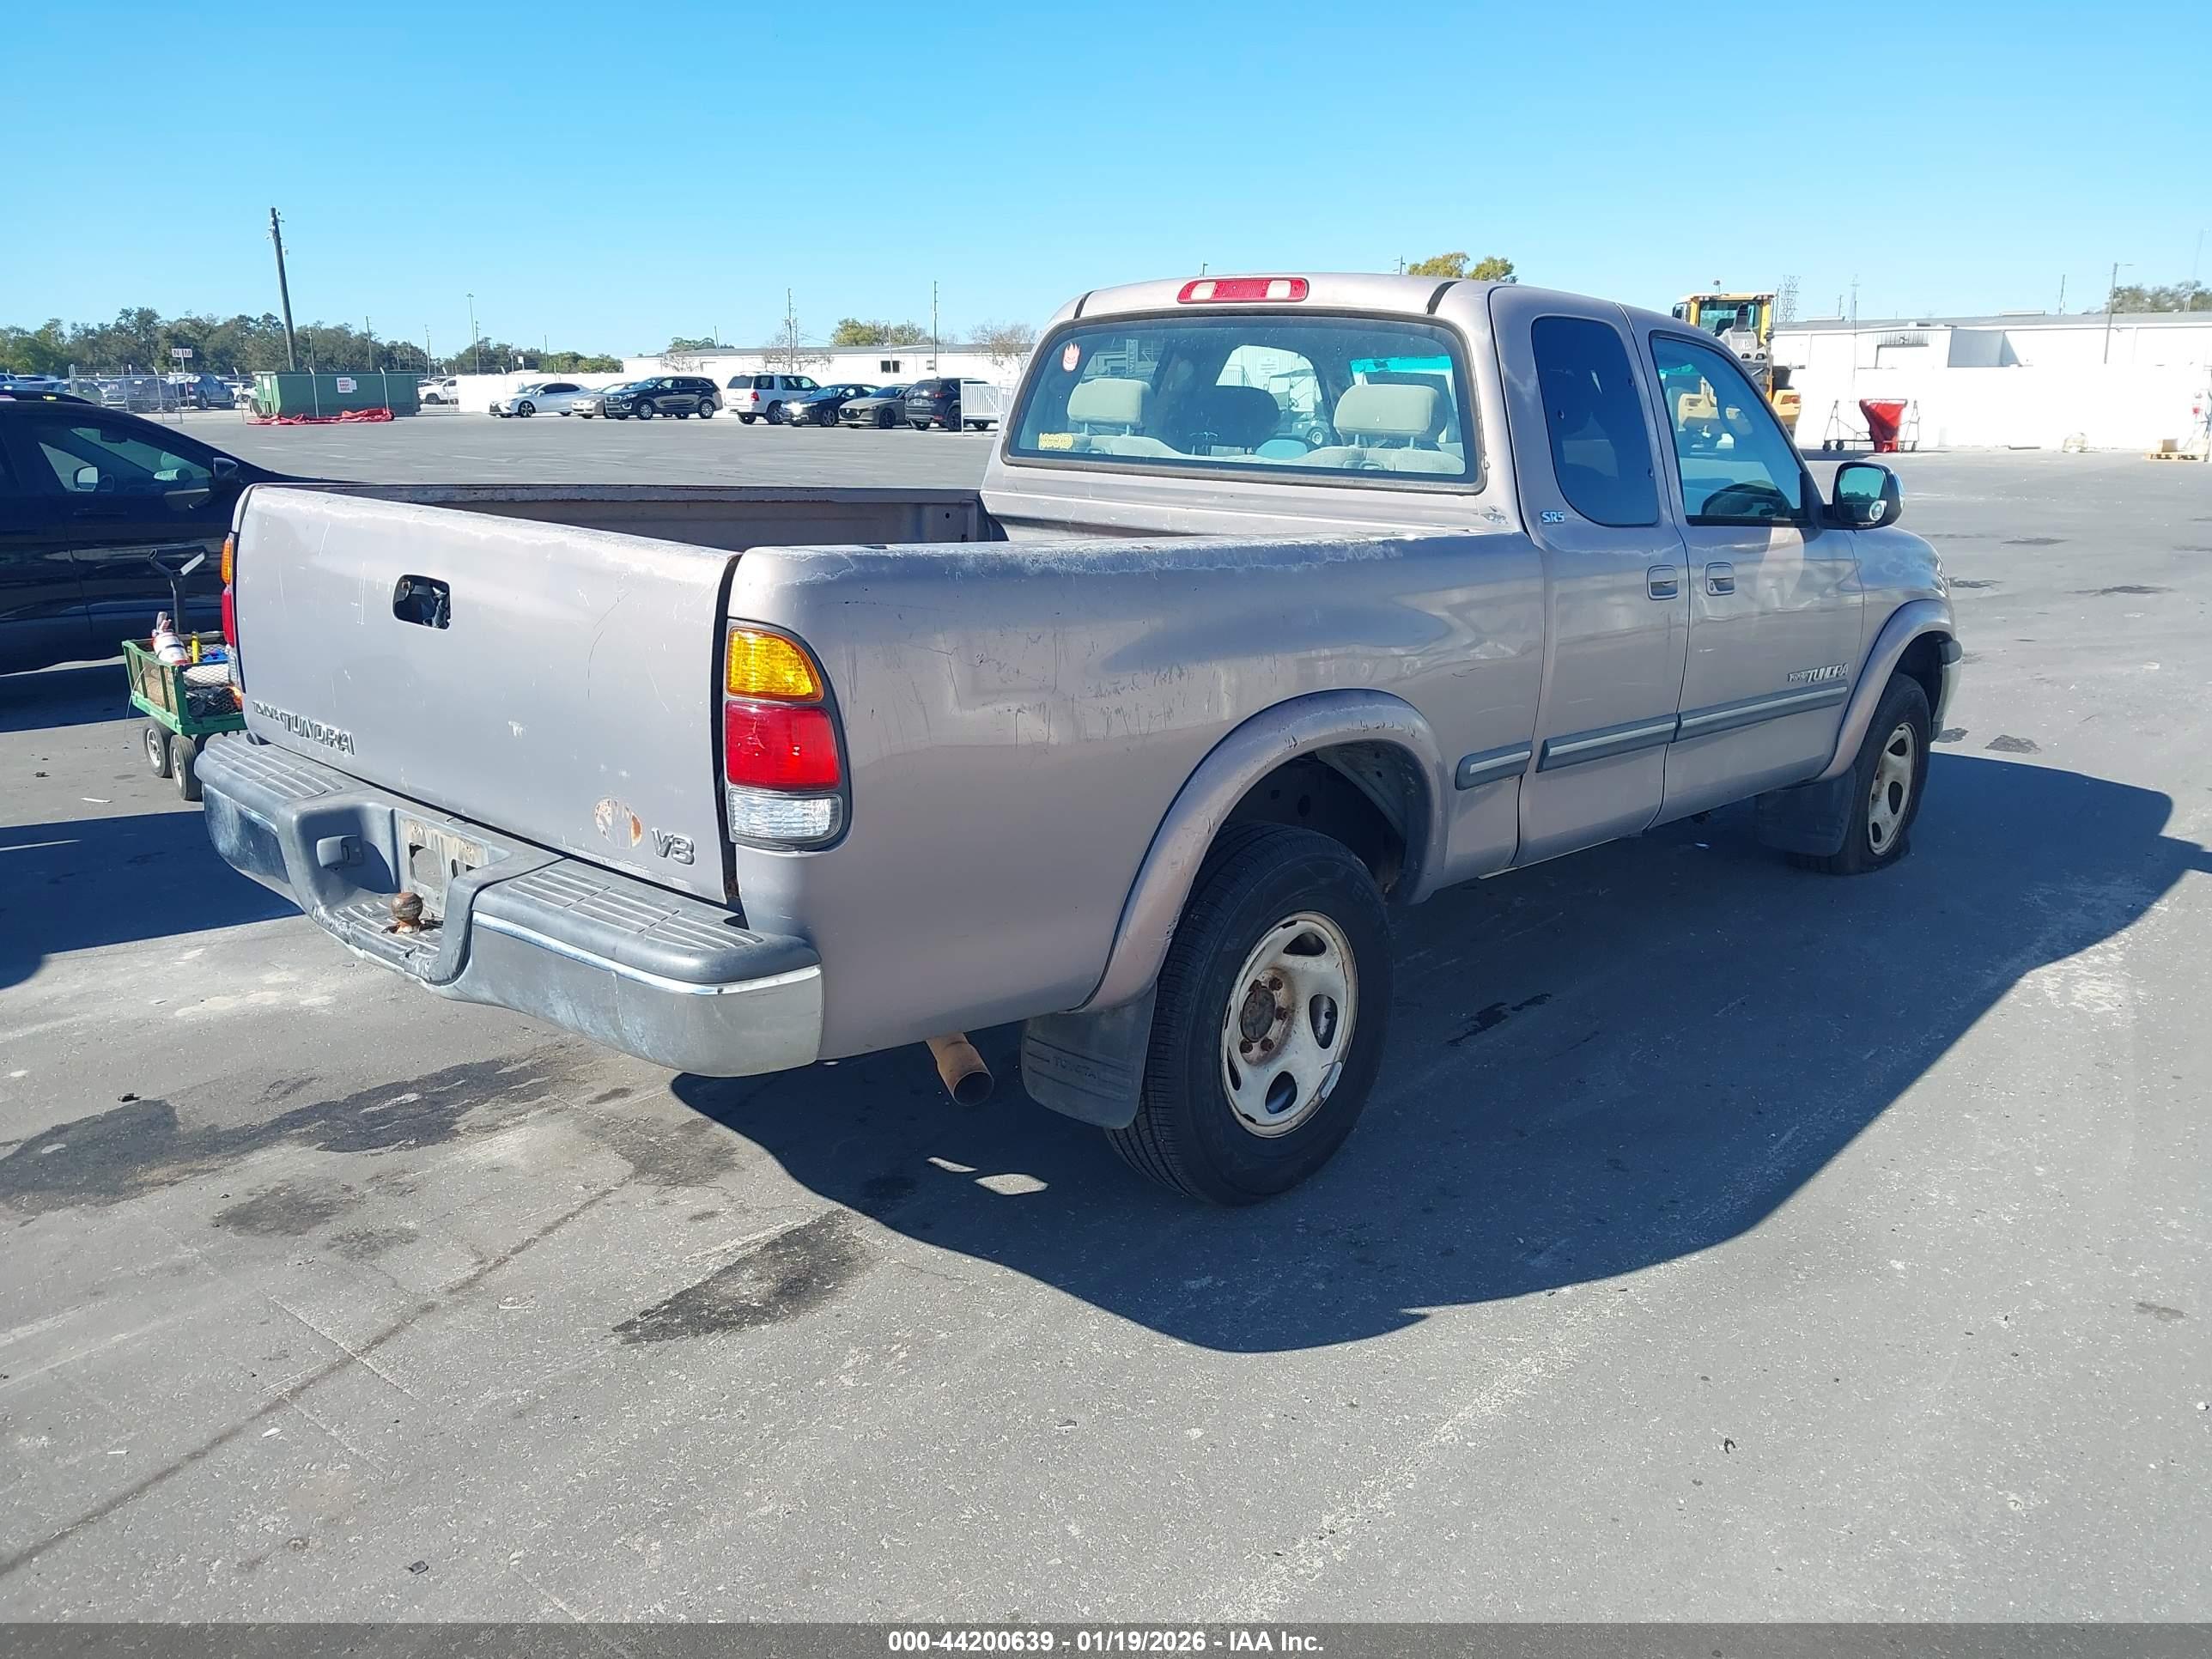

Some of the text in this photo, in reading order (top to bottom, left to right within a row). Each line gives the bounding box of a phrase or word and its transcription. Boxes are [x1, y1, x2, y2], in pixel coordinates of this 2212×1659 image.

[1541, 511, 1565, 523] SR5
[1806, 662, 1849, 684] TUNDRA
[280, 710, 356, 756] TUNDRA
[652, 828, 695, 866] V8
